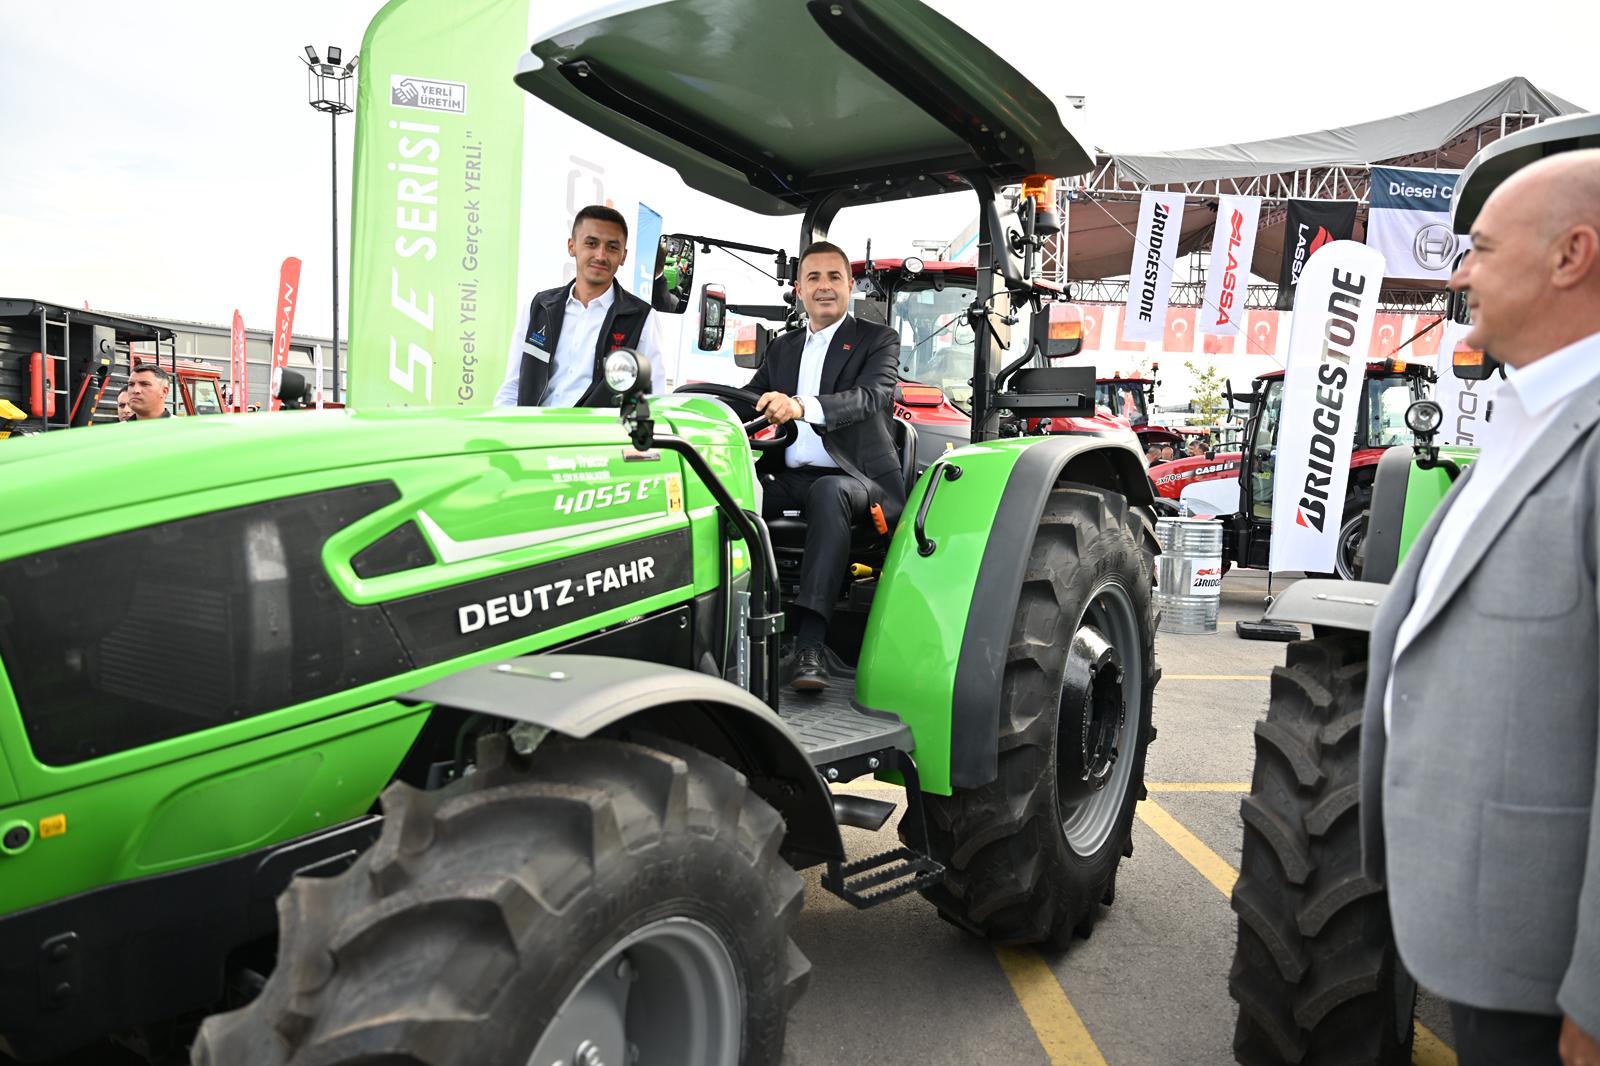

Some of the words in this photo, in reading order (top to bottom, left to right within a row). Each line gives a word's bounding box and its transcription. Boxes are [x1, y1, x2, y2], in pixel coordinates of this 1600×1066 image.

[420, 95, 461, 109] ÜRETİM
[421, 84, 453, 97] YERLİ
[388, 119, 441, 261] SERİSİ
[1389, 181, 1438, 199] Diesel
[462, 199, 483, 270] Gerçek
[1139, 201, 1171, 323] BRIDGESTONE
[1290, 222, 1310, 286] LASSA
[458, 278, 480, 325] YENİ,
[1216, 237, 1242, 326] LASSA
[1295, 267, 1366, 534] BRIDGESTONE
[553, 482, 632, 515] 4055
[1195, 463, 1223, 475] CASE
[458, 556, 656, 634] DEUTZ-FAHR
